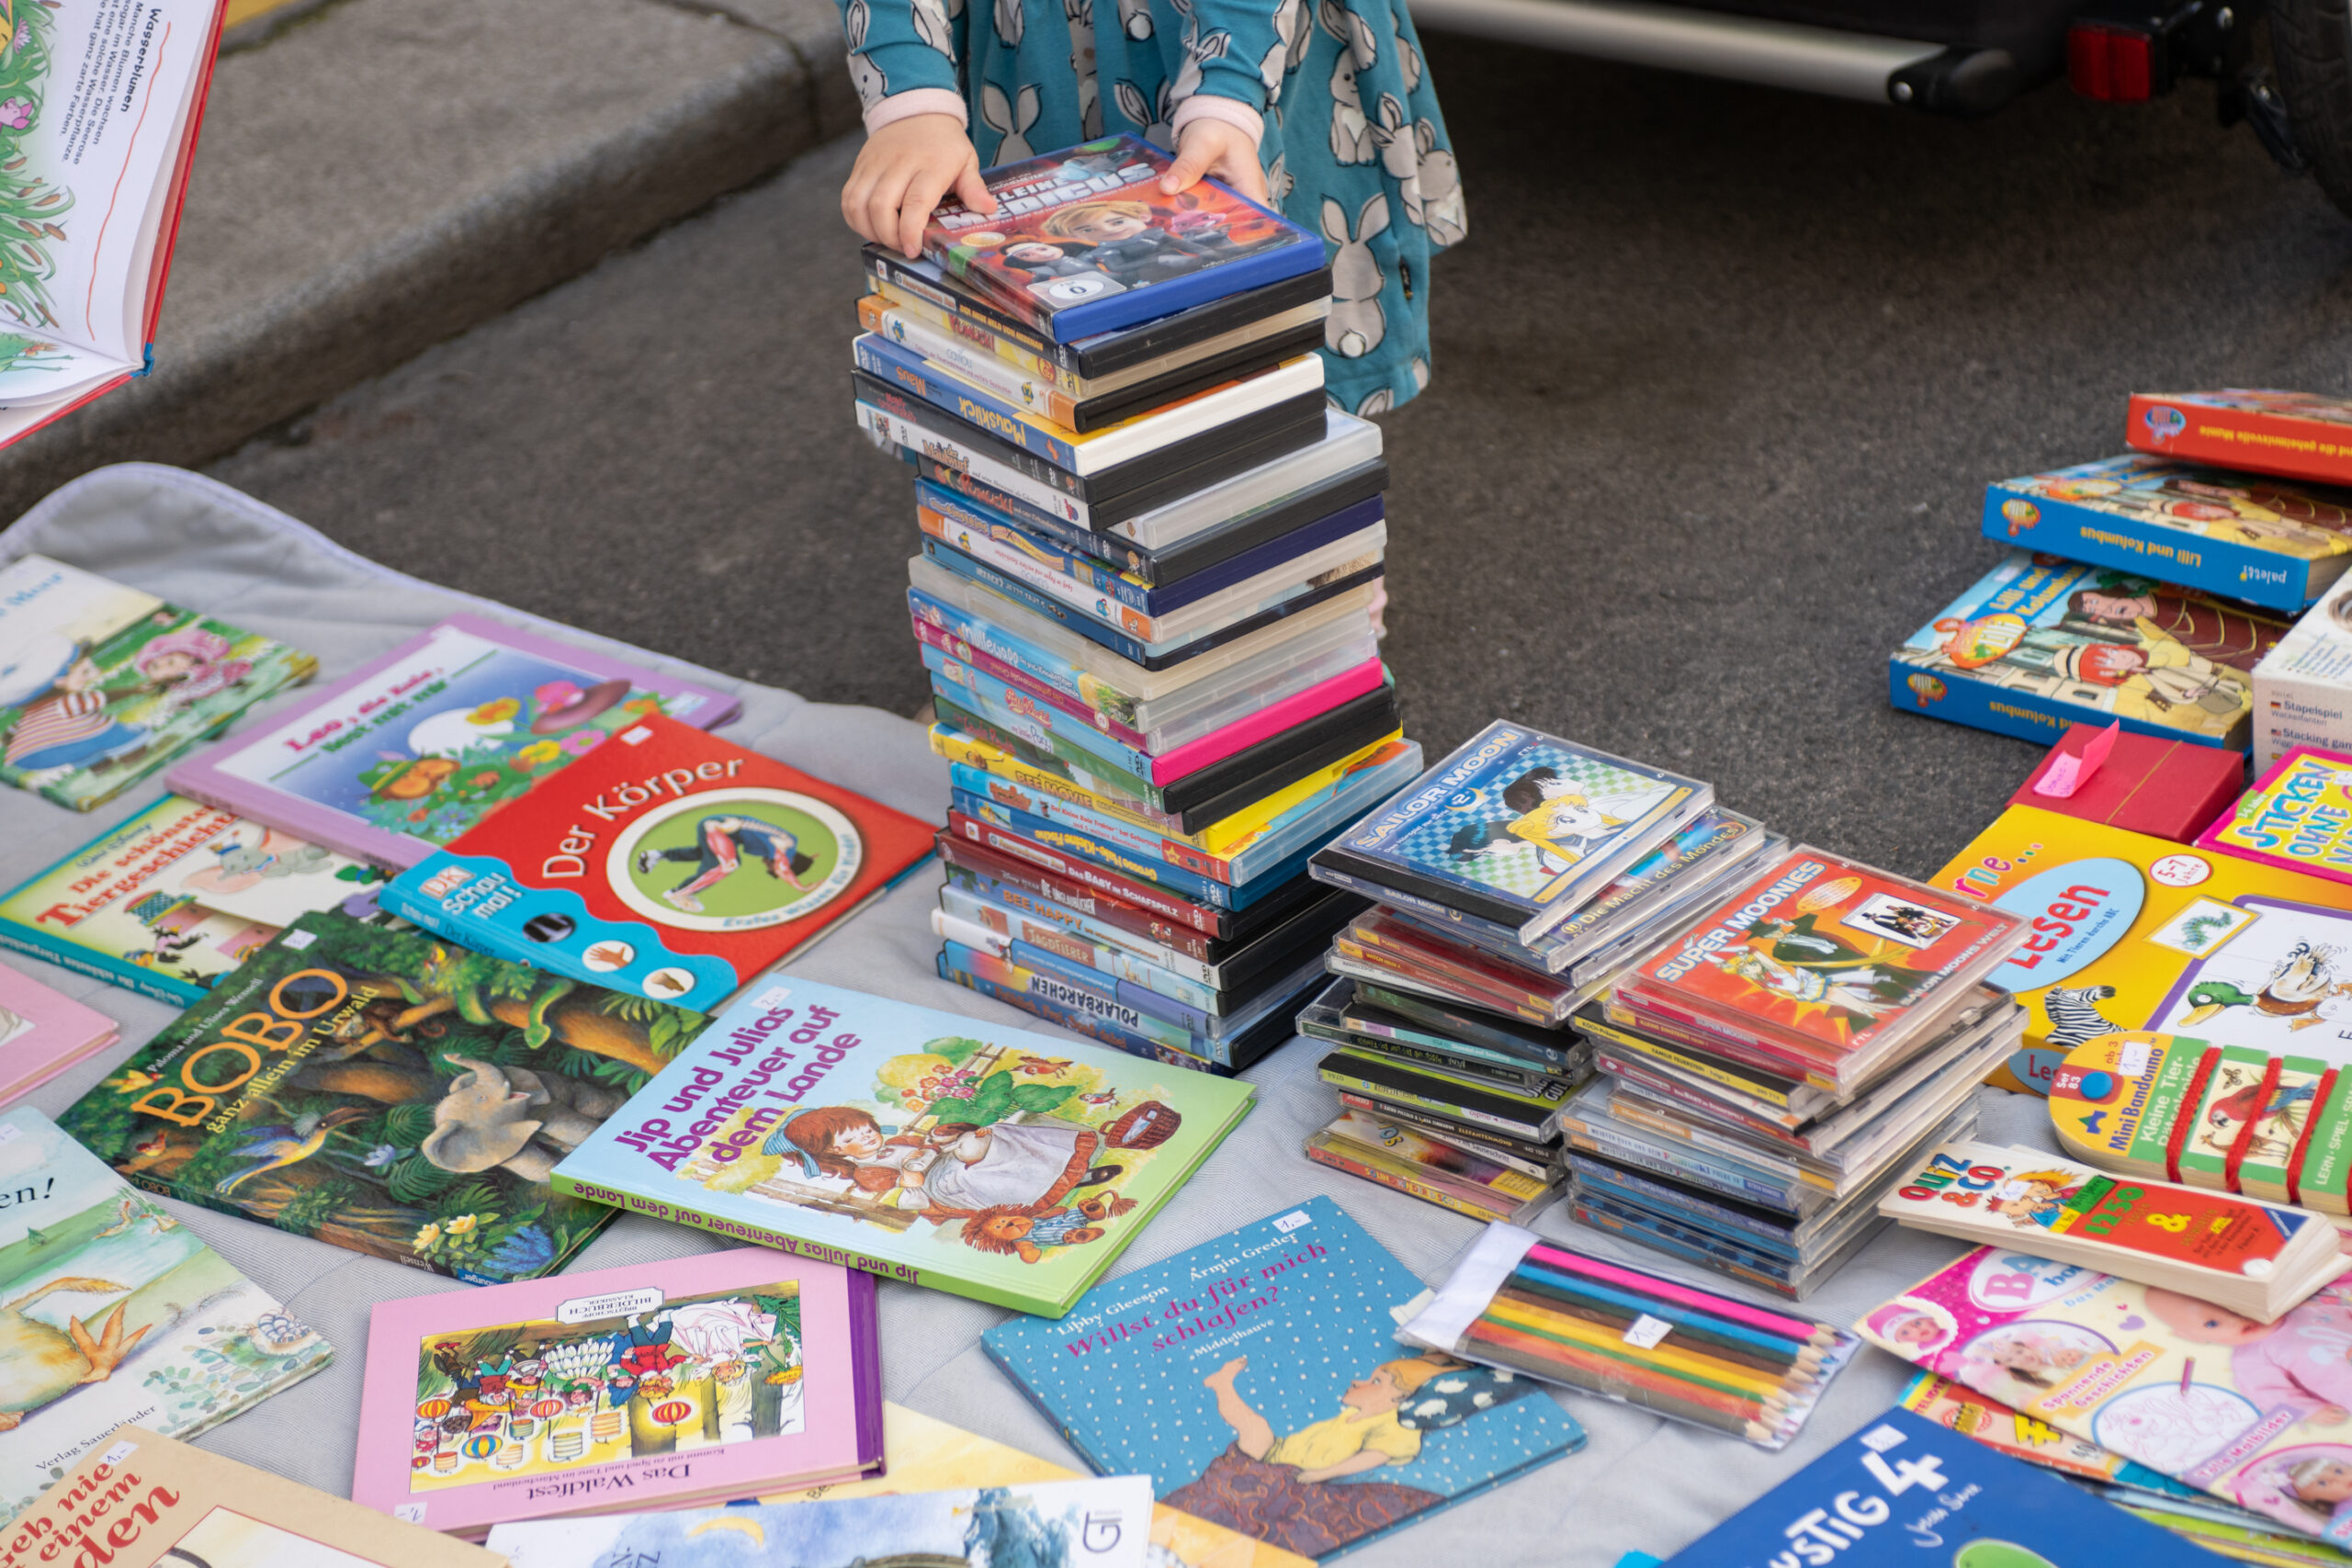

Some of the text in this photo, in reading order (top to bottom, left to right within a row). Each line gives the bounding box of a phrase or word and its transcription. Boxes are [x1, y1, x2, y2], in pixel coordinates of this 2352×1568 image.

[110, 49, 130, 94] Blumen
[92, 95, 115, 146] wachsen
[936, 162, 1158, 231] MEDICUS
[2079, 525, 2203, 569] Lilli und Kolumbus
[2241, 564, 2288, 586] paletti
[1989, 699, 2056, 729] Kolumbus
[2284, 700, 2344, 720] Stapelspiel
[2282, 728, 2330, 749] Stacking
[1014, 770, 1093, 809] BEE MOVIE
[1355, 730, 1521, 849] SAILOR MOON
[2235, 760, 2338, 850] STICKEN
[542, 757, 746, 880] Der Körper
[2285, 803, 2350, 857] OHNE
[68, 867, 113, 896] Die
[443, 872, 507, 915] Schau
[1577, 823, 1741, 926] Die Macht des Mondes
[2157, 858, 2188, 880] 5-7
[1002, 889, 1083, 931] BEE HAPPY
[1385, 886, 1447, 915] SAILOR MOON
[1656, 860, 1827, 983] SUPER MOONIES
[2007, 882, 2112, 971] Lesen
[1938, 944, 1979, 983] MOONS
[1976, 921, 2010, 949] WELT
[1030, 976, 1140, 1029] POLARBÄRCHEN
[130, 967, 348, 1127] BOBO
[206, 985, 380, 1135] ganz allein im Urwald
[613, 1006, 795, 1154] Jip und Julias
[646, 1003, 842, 1173] Abenteuer auf
[711, 1032, 863, 1163] dem Lande
[2055, 1072, 2082, 1090] Set 83
[2108, 1117, 2138, 1152] Mini
[2140, 1093, 2171, 1143] Kleine
[2315, 1119, 2350, 1186] LERN SPIEL
[573, 1181, 920, 1283] Jip und Julias Abenteuer auf dem Lande
[2084, 1186, 2146, 1236] 1250
[568, 1294, 653, 1316] BILDERBUCH
[1057, 1231, 1297, 1337] Libby Gleeson Armin Greder
[1065, 1242, 1329, 1359] Willst du für mich
[1151, 1285, 1281, 1352] schlafen?
[1193, 1317, 1276, 1358] Middelhauve
[2040, 1359, 2114, 1412] Spannende
[2073, 1349, 2155, 1409] Geschichten
[36, 1404, 157, 1471] Verlag Sauerländer
[2230, 1410, 2294, 1459] Malbilder
[56, 1462, 115, 1513] nie
[526, 1463, 692, 1502] Das Waldfest
[1860, 1450, 1951, 1497] 4
[39, 1472, 142, 1562] einem
